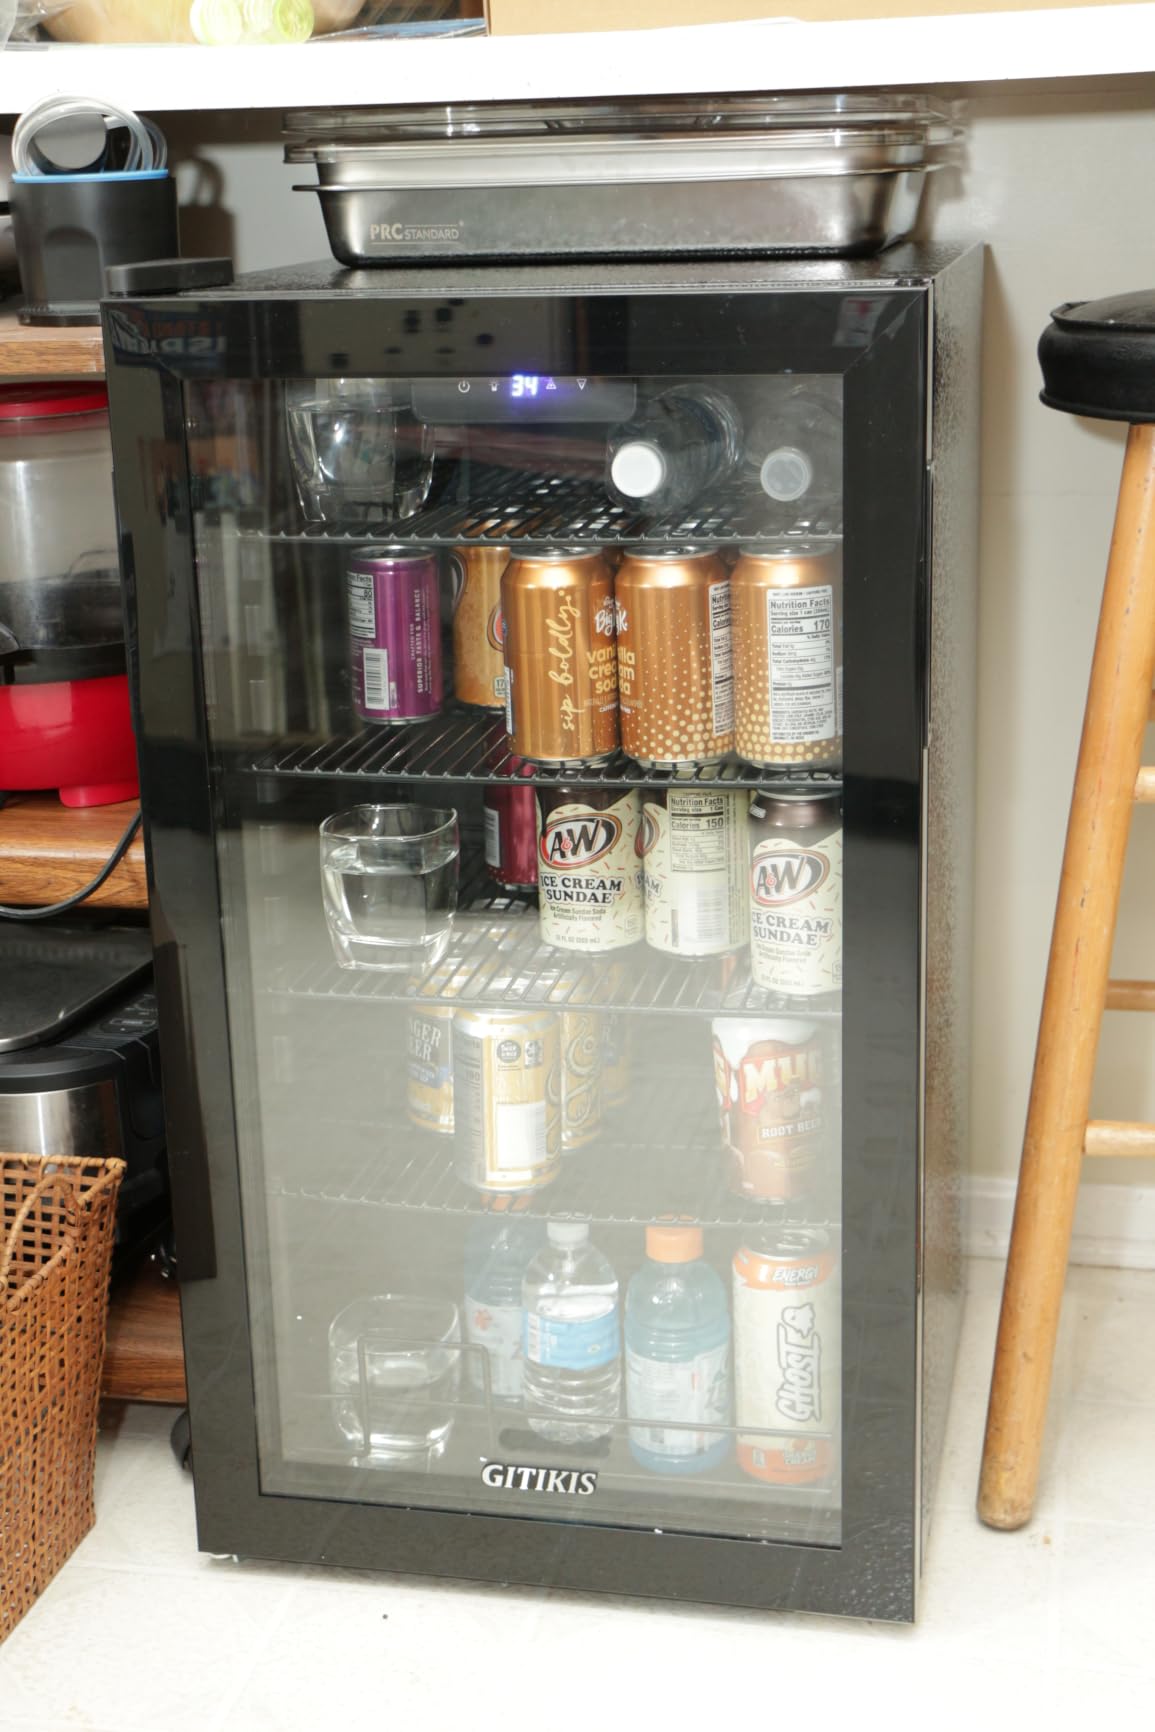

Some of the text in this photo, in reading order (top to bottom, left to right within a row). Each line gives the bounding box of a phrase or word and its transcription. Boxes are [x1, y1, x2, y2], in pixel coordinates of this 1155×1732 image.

[370, 223, 460, 241] PRC STANDARD
[511, 375, 538, 397] 34
[770, 598, 830, 609] Nutrition Facts
[771, 618, 830, 633] Calories 170
[671, 796, 723, 806] Nutrition Facts
[671, 817, 724, 829] Calories 150
[549, 818, 602, 862] A&W
[541, 875, 622, 892] ICE CREAM
[755, 855, 808, 897] A&W
[546, 888, 612, 904] SUNDAE
[766, 914, 831, 934] CREAM
[754, 927, 818, 947] SUNDAE
[762, 1124, 793, 1138] ROOT
[775, 1321, 823, 1423] GHOST
[481, 1463, 597, 1496] GITIKIS
